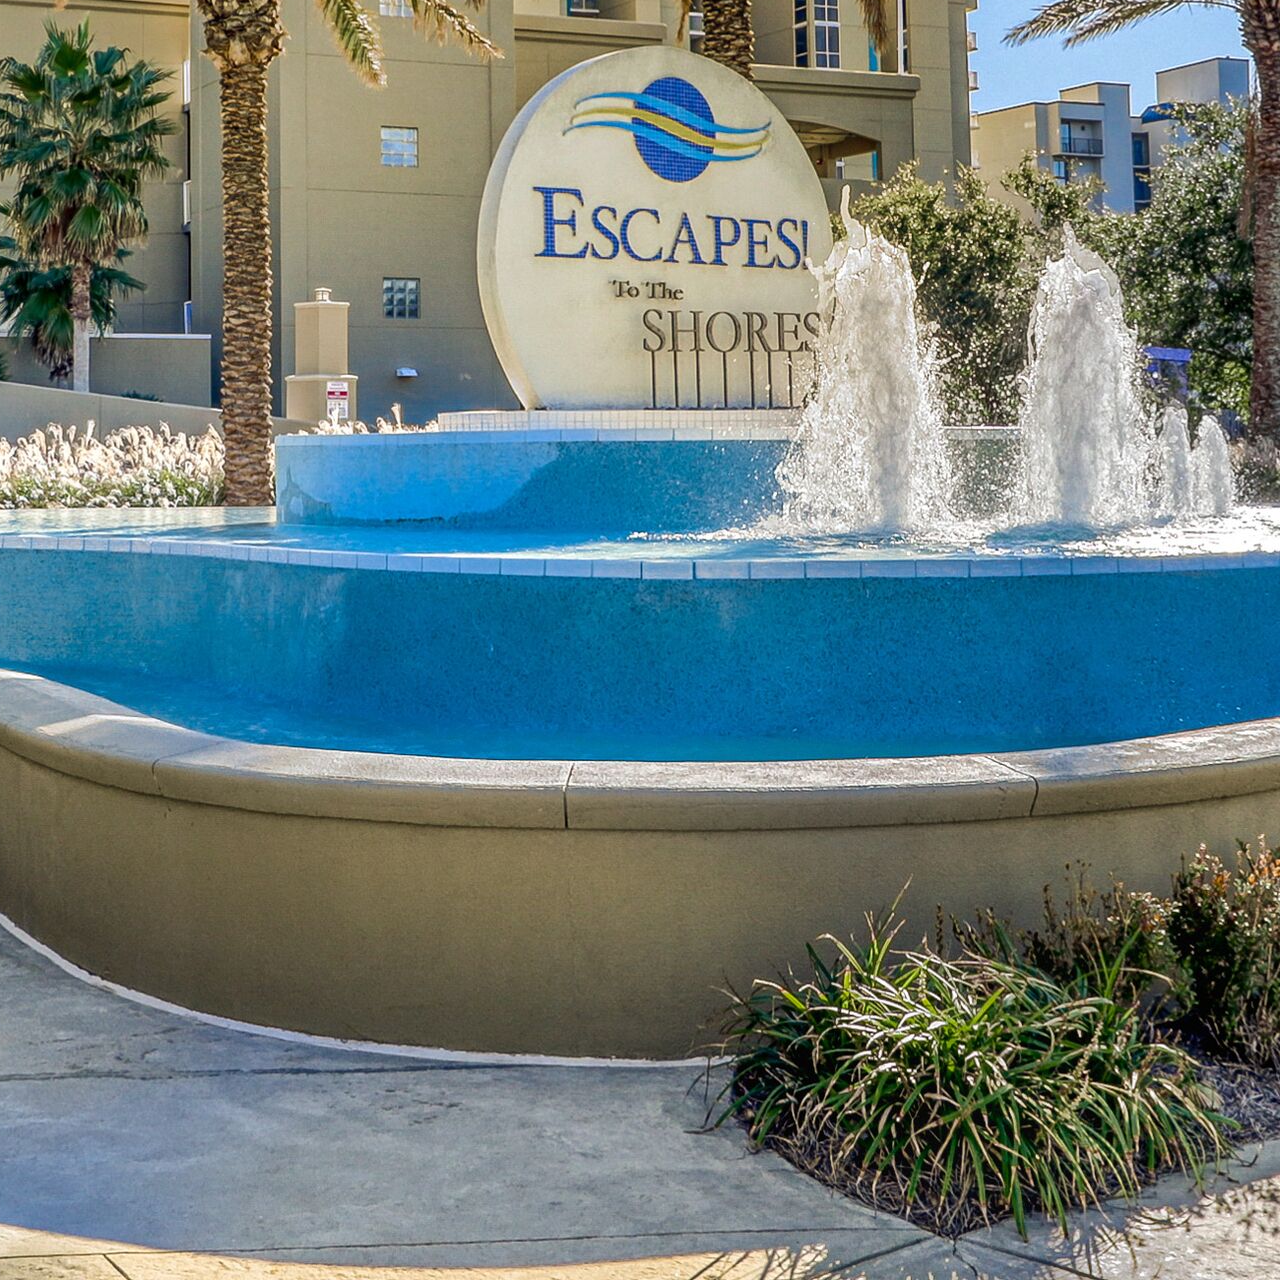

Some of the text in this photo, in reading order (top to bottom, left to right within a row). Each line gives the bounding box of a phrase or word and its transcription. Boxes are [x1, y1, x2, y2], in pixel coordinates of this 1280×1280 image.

[532, 186, 809, 270] ESCAPES!
[611, 279, 684, 300] To The
